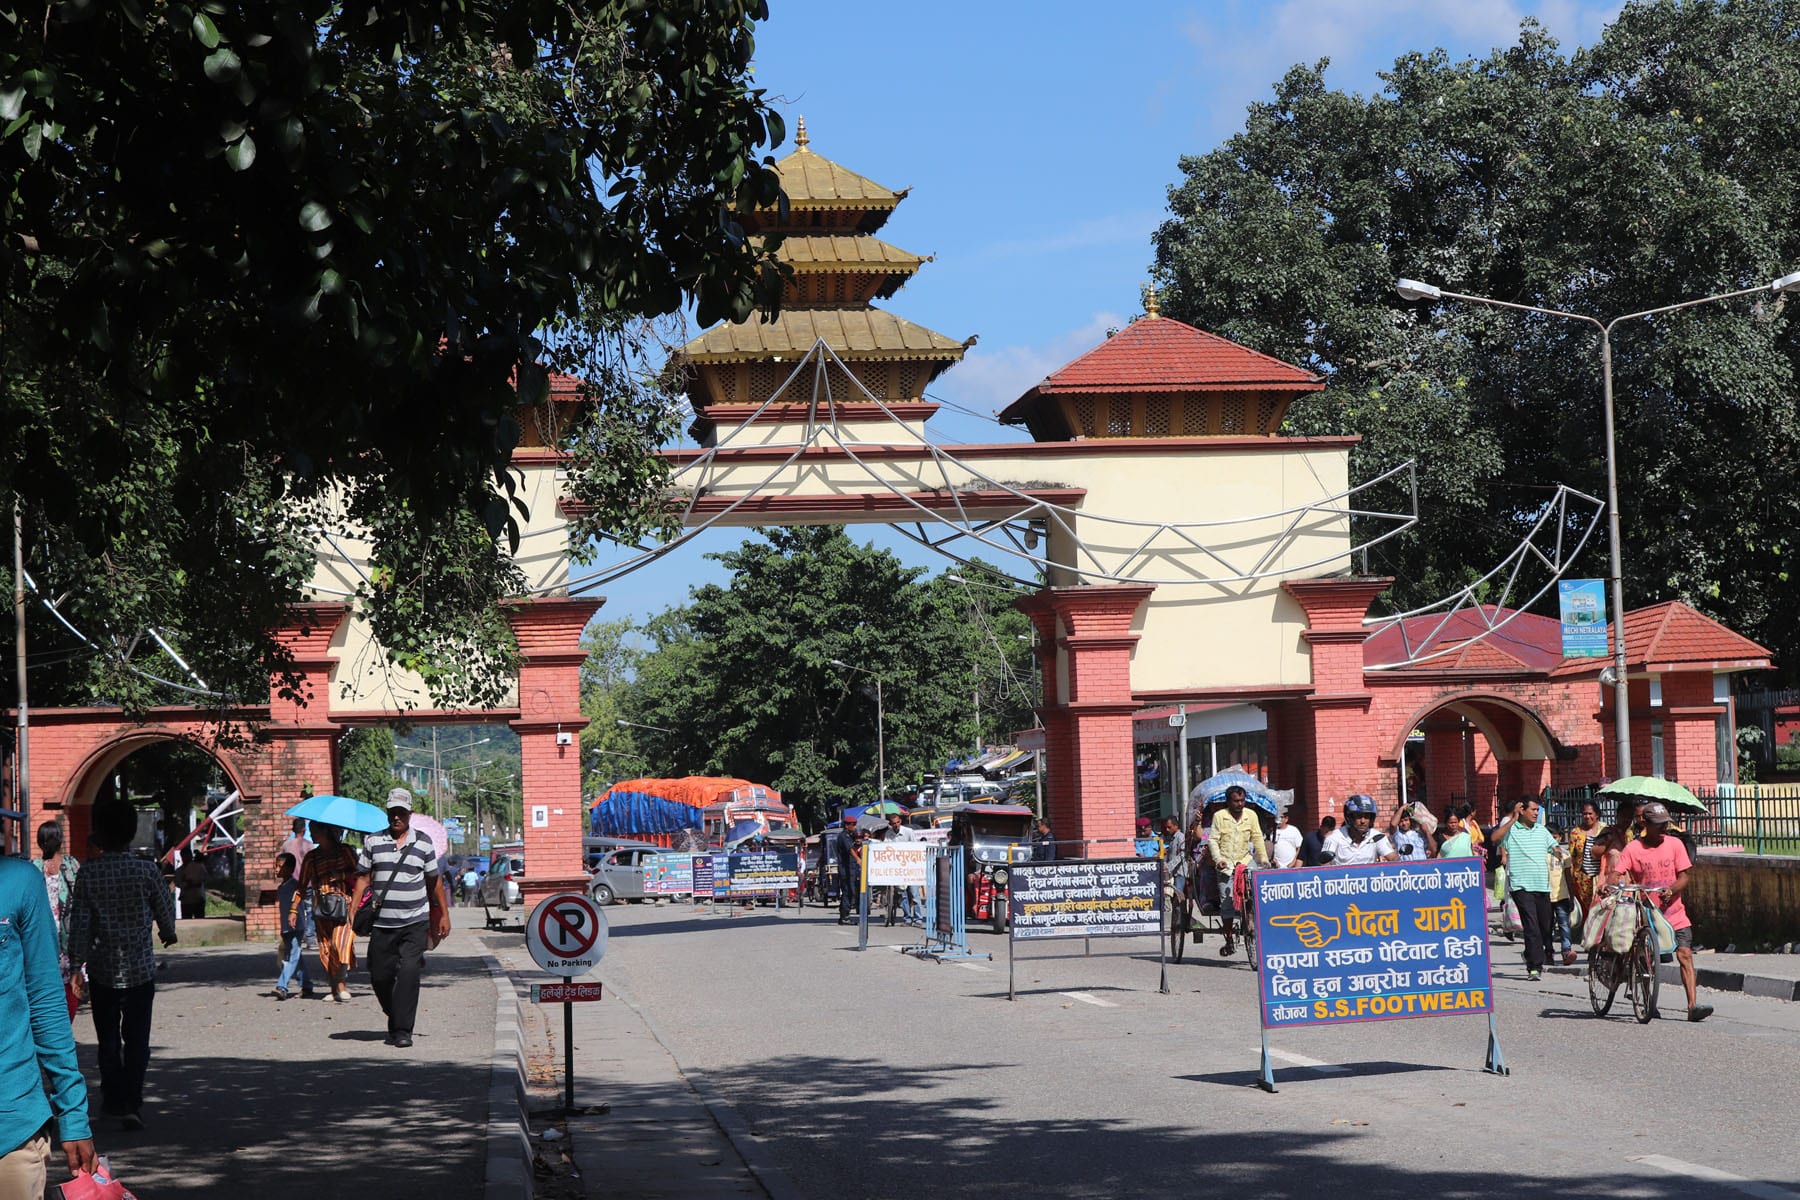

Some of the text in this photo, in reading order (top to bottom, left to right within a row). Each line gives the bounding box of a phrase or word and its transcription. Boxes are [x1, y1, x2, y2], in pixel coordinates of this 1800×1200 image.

[872, 846, 896, 863] प्रहरी
[871, 868, 894, 876] POLICE
[1297, 875, 1322, 900] प्रहरी
[1324, 874, 1368, 896] कार्यालय
[1444, 867, 1480, 893] अनुरोध
[1345, 897, 1466, 936] पैदल यात्री
[1266, 951, 1319, 974] कृपया
[1325, 947, 1373, 967] सडक
[1272, 974, 1307, 999] दिनु
[1313, 976, 1342, 998] हुन
[1348, 969, 1411, 994] अनुरोध
[1272, 990, 1486, 1021] सौजन्य S.S.FOOTWEAR
